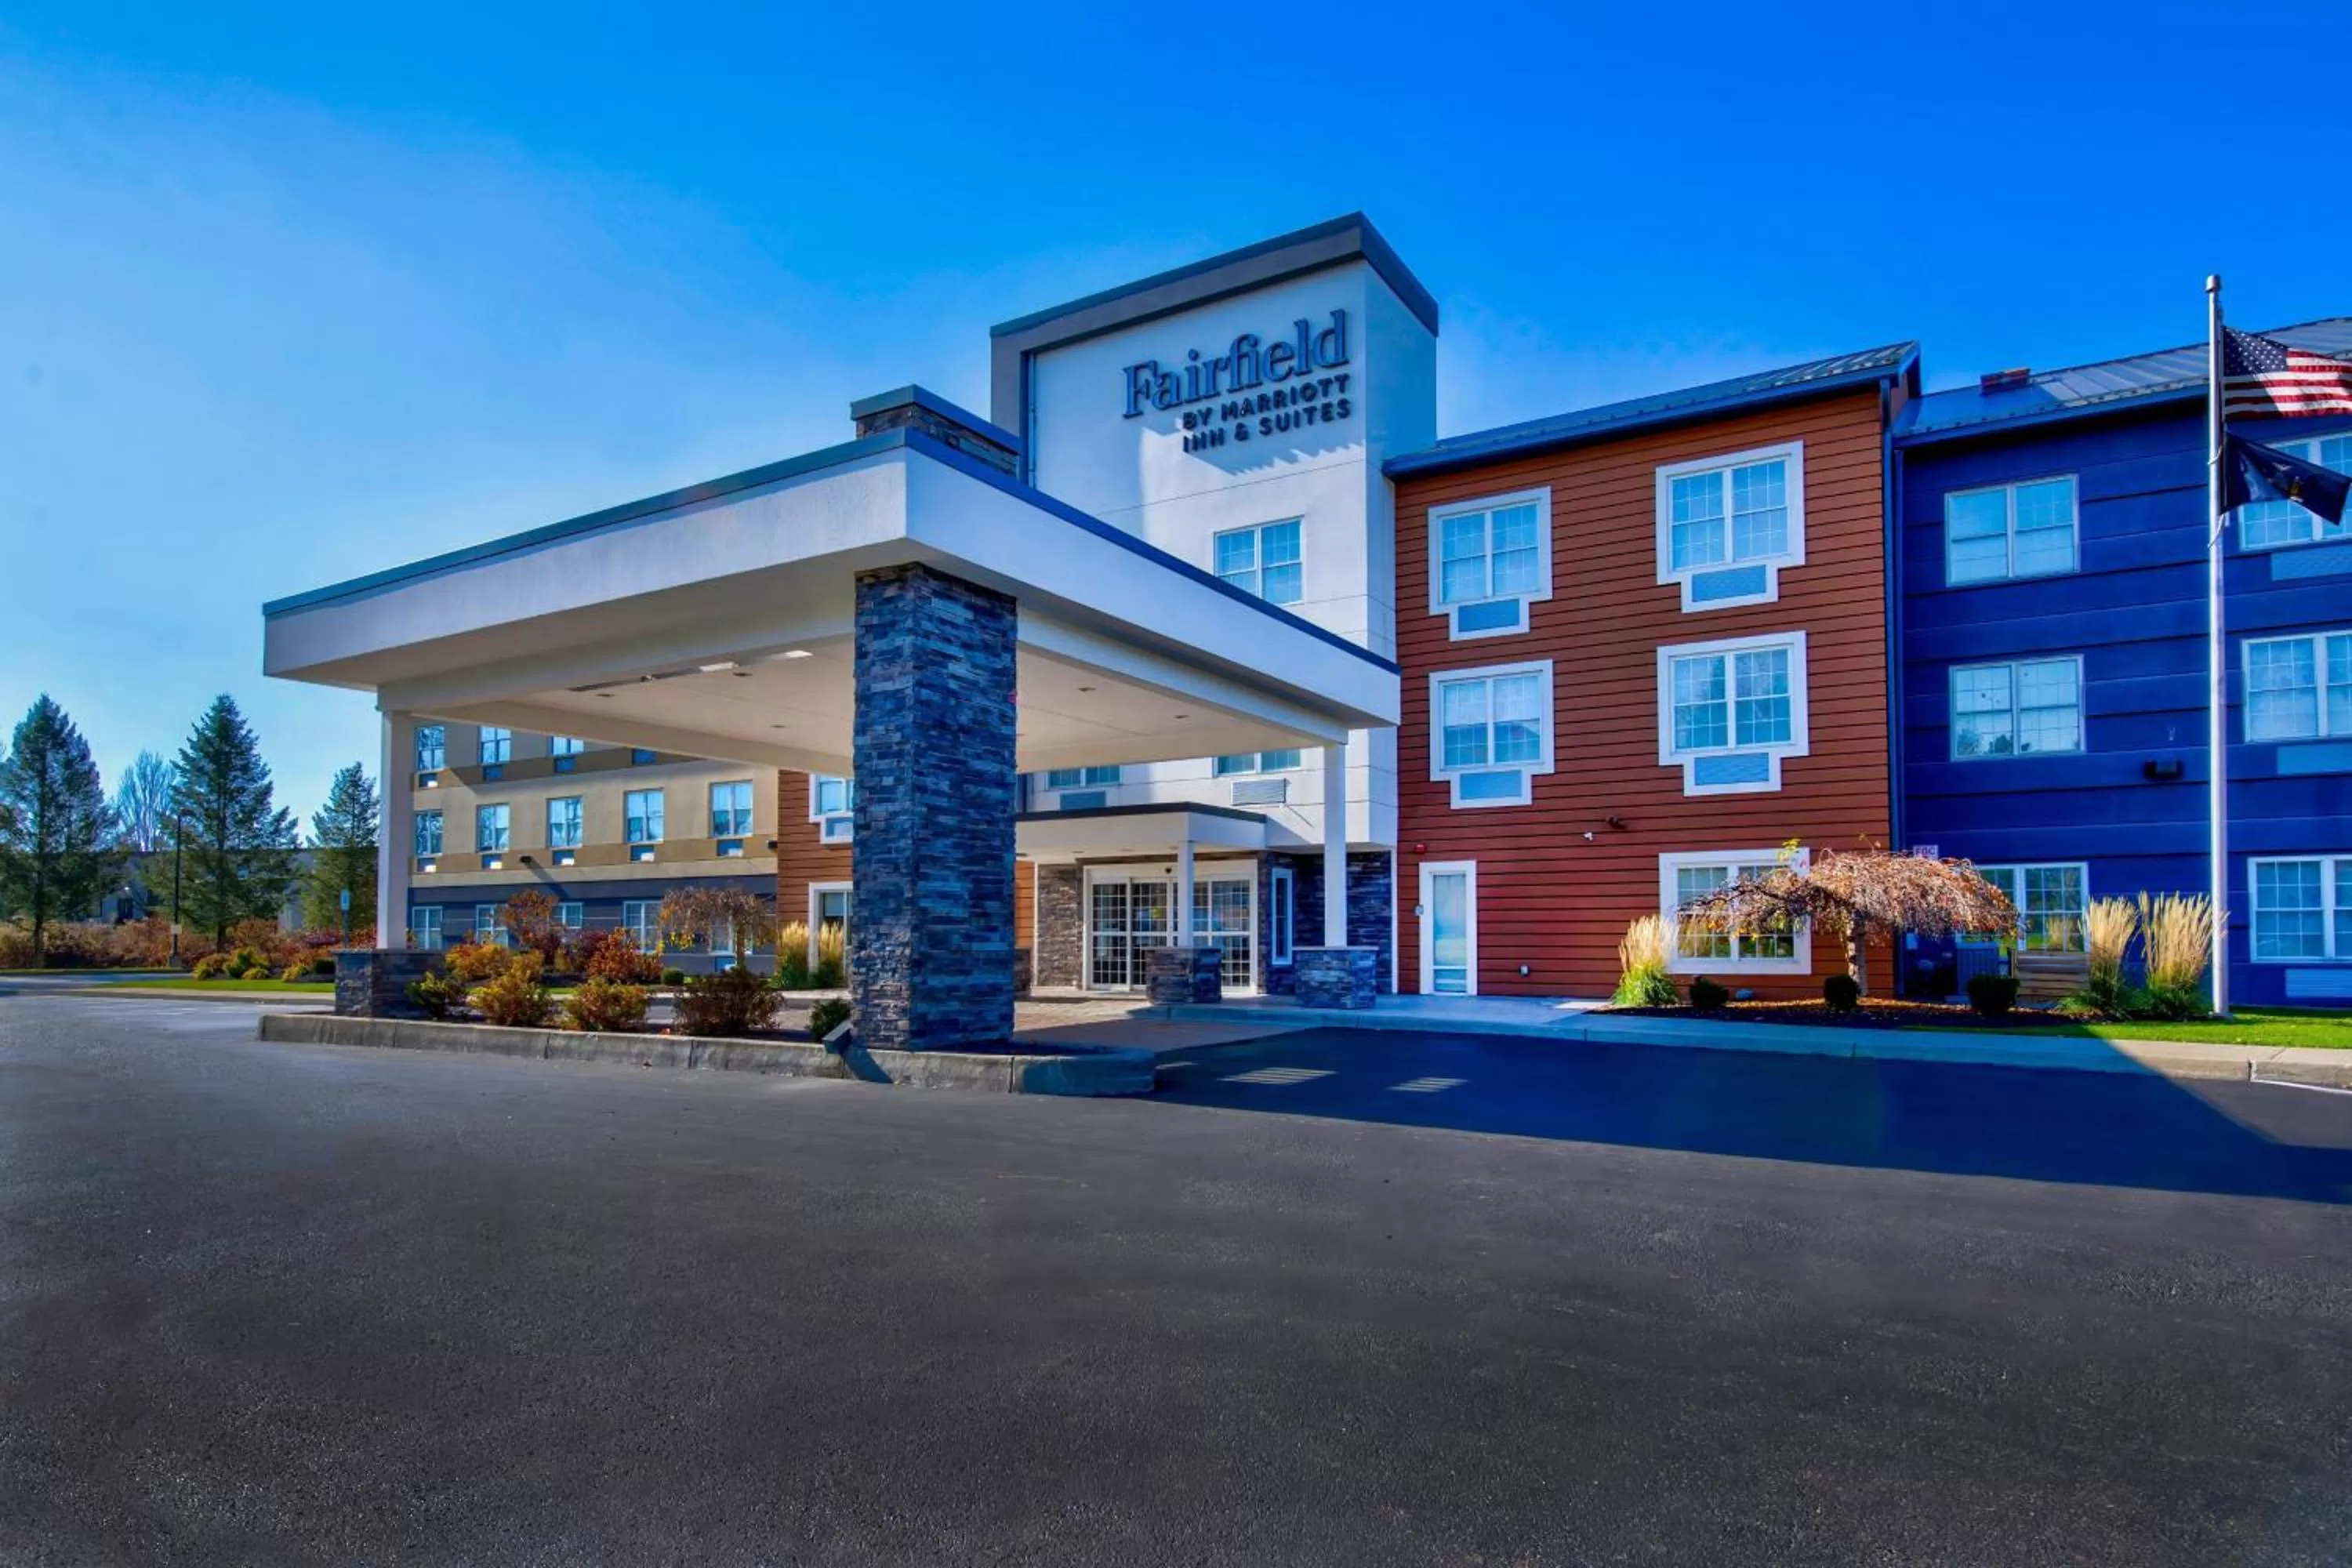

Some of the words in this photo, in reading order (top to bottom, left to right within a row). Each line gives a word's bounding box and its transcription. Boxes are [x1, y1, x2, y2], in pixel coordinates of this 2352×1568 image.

[1122, 308, 1350, 419] Fairfield
[1182, 407, 1213, 430] BY
[1220, 372, 1350, 422] MARRIOTT
[1182, 427, 1225, 454] INN
[1234, 422, 1250, 441] &
[1258, 397, 1352, 436] SUITES
